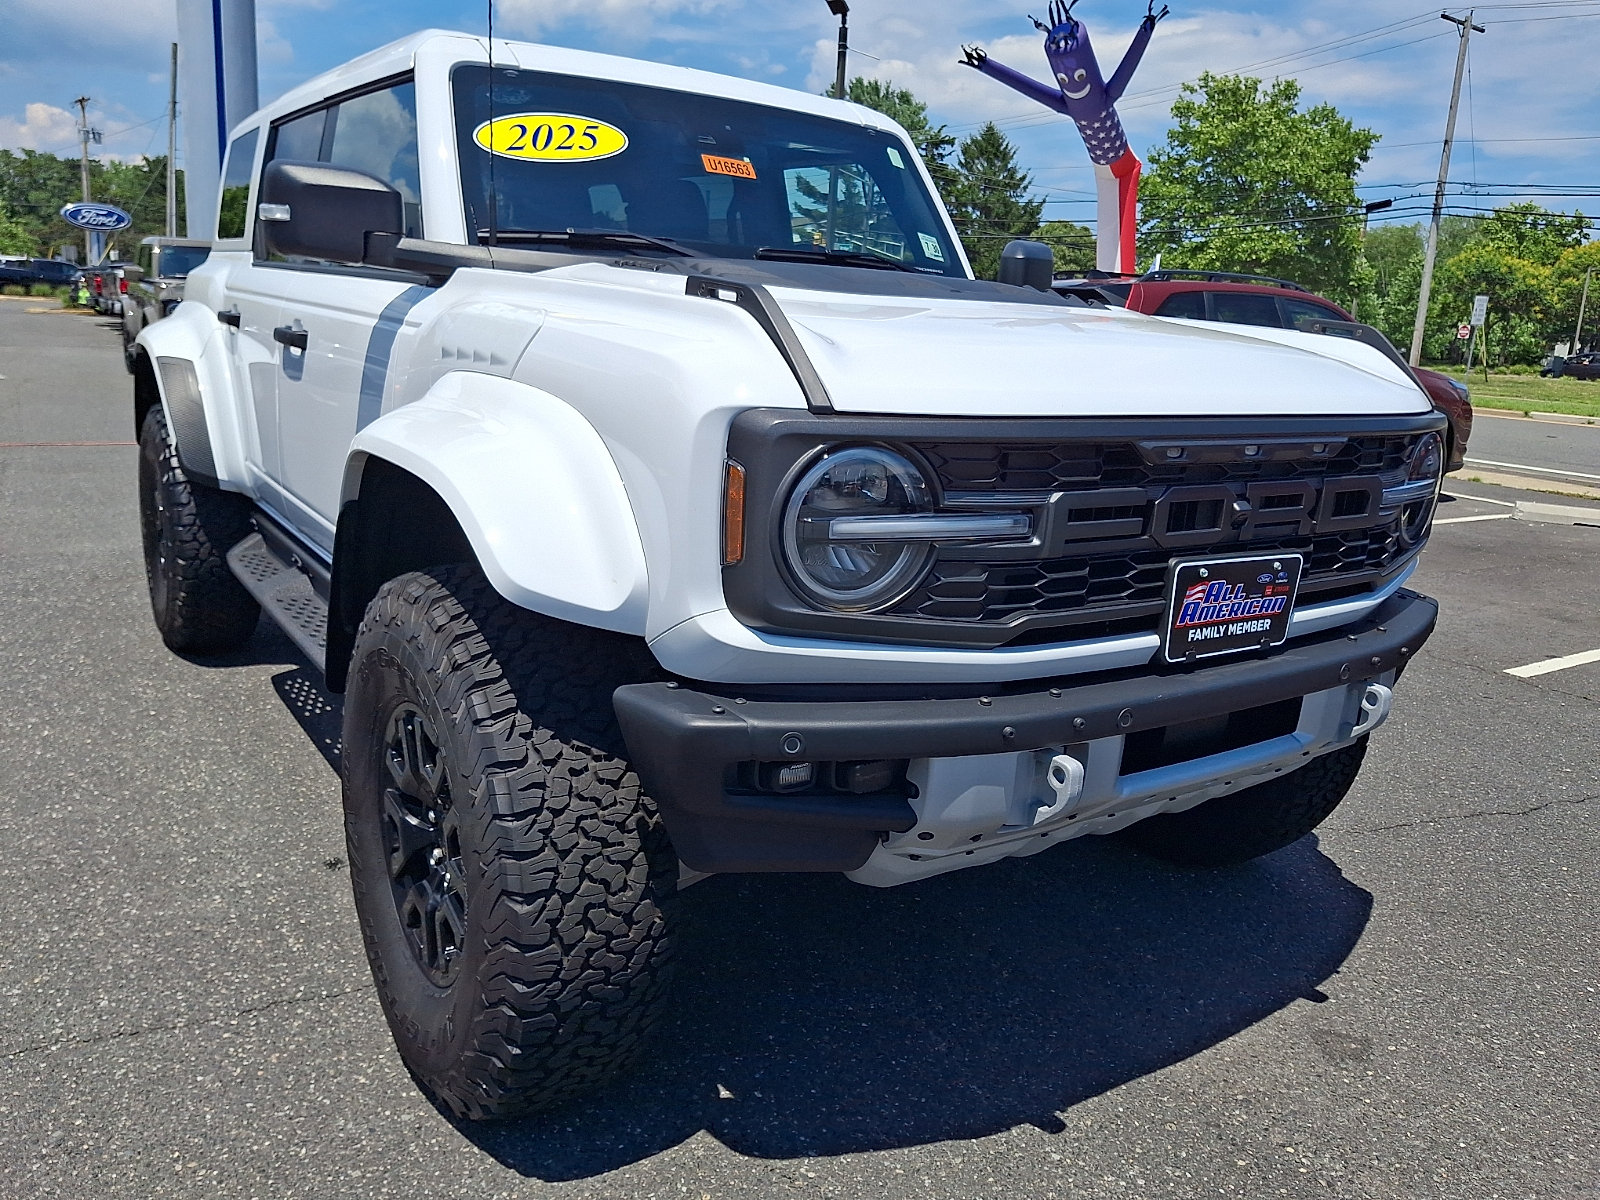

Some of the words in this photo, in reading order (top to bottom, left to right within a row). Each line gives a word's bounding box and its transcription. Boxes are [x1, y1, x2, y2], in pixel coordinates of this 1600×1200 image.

[506, 123, 600, 151] 2025
[708, 158, 752, 177] U16563
[77, 209, 118, 227] Ford
[1045, 475, 1382, 558] FORD
[1187, 624, 1228, 642] FAMILY
[1228, 619, 1271, 636] MEMBER
